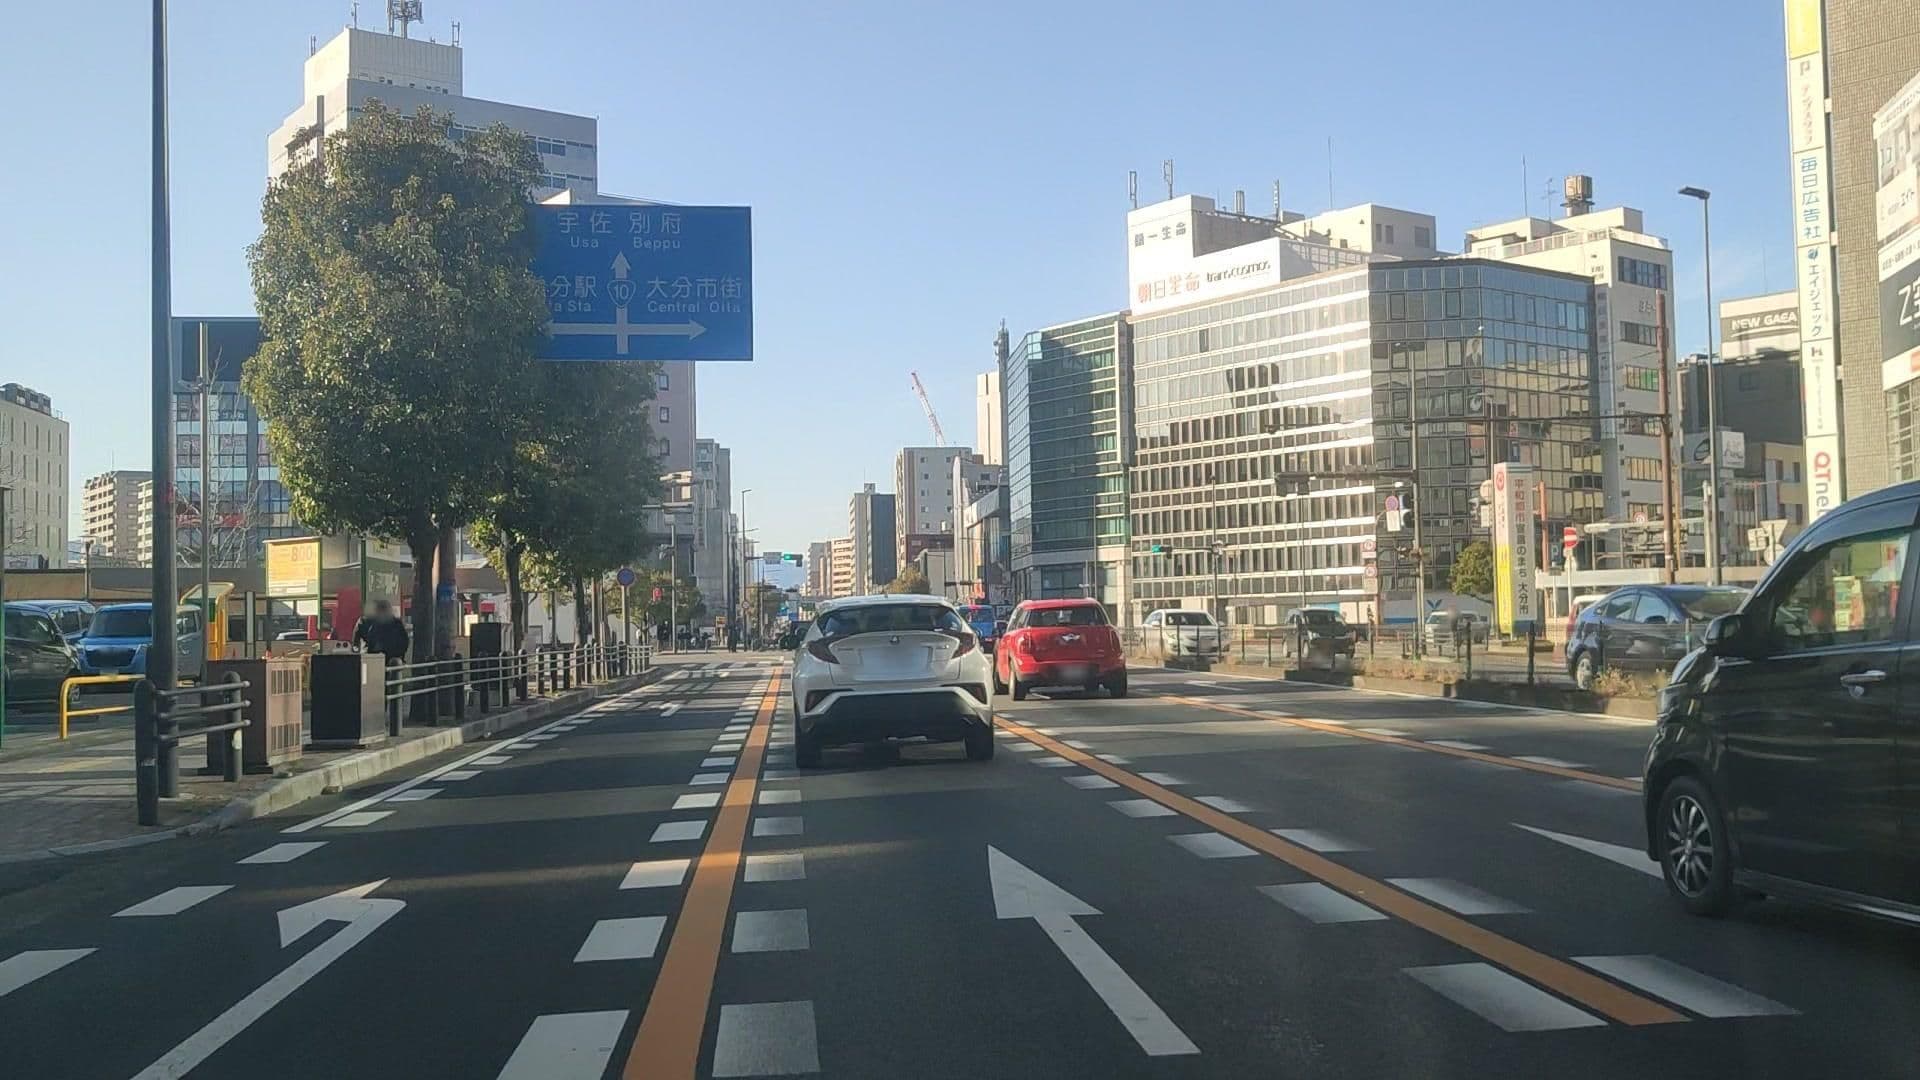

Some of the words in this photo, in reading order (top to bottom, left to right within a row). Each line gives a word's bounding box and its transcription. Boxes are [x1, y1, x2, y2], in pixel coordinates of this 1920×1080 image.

[1800, 156, 1822, 239] 毎日広告社
[558, 211, 612, 234] 宇佐
[629, 211, 681, 234] 別府
[570, 236, 599, 248] Usa
[633, 237, 681, 251] Beppu
[549, 275, 598, 298] 分駅
[613, 284, 630, 300] 10
[647, 276, 742, 298] 大分市街
[648, 301, 700, 313] Central
[1808, 264, 1823, 337] エイジェック
[1731, 316, 1761, 331] NEW
[1518, 581, 1529, 615] 大分市
